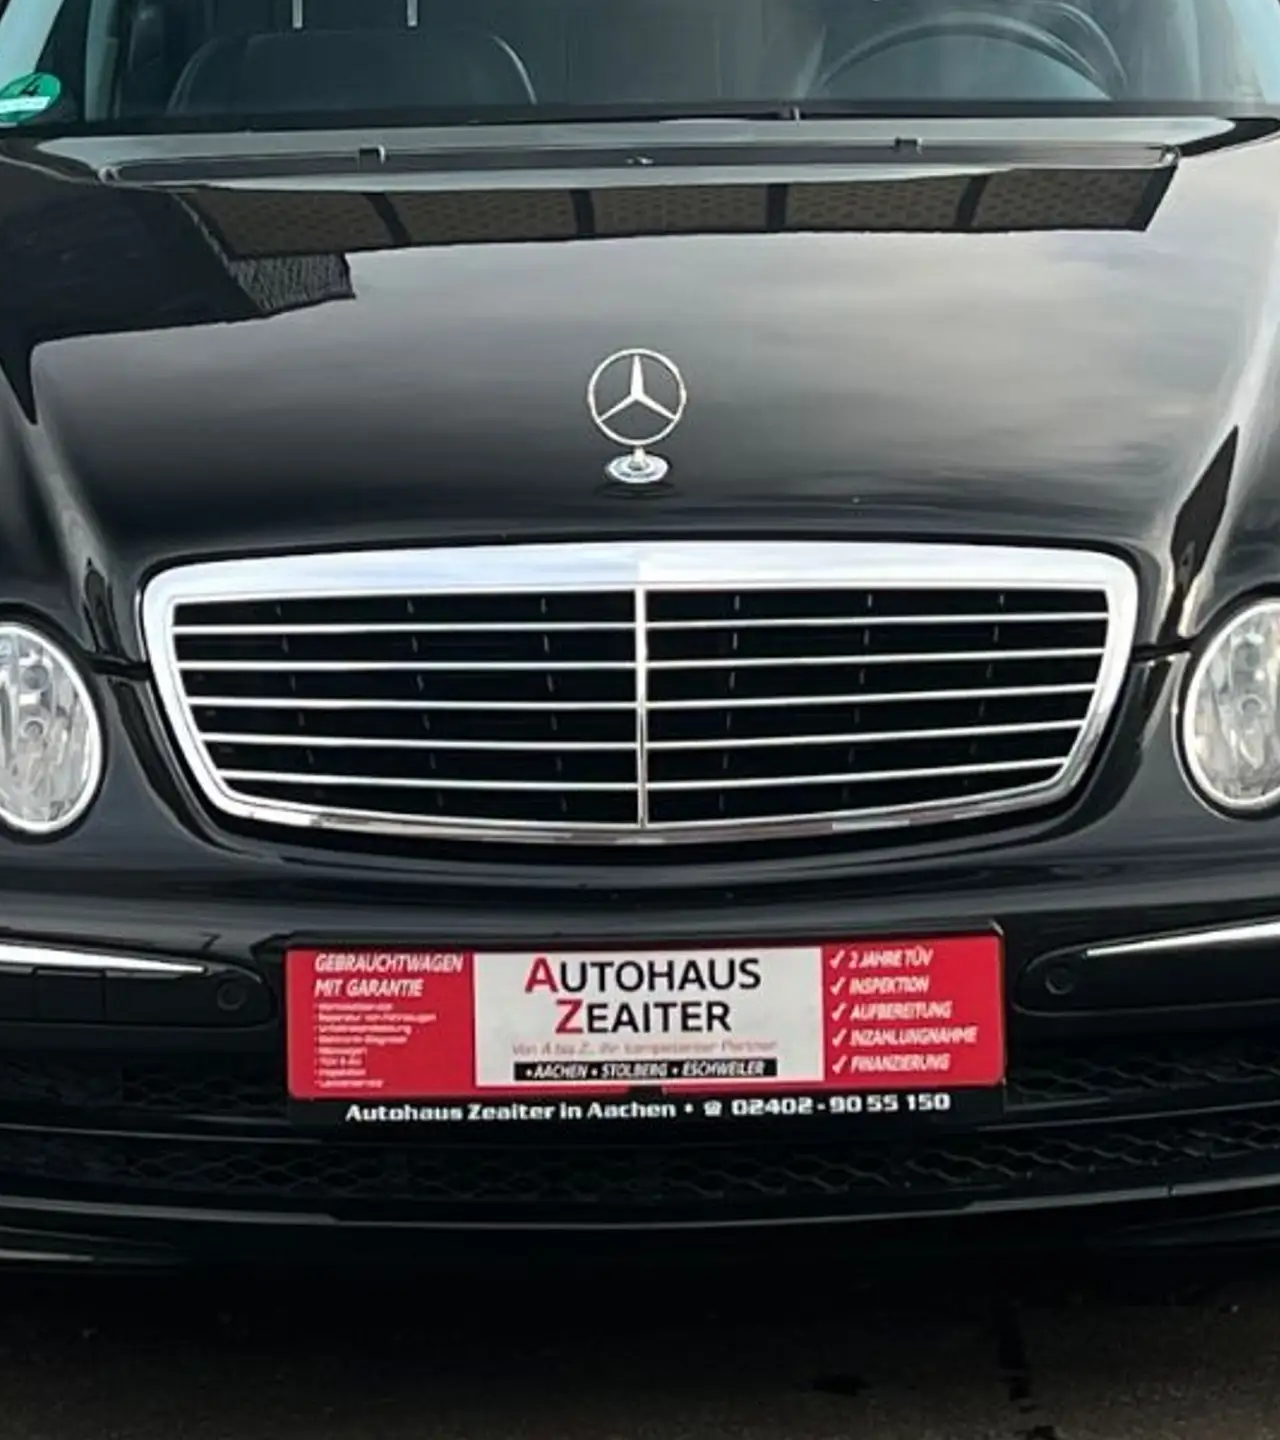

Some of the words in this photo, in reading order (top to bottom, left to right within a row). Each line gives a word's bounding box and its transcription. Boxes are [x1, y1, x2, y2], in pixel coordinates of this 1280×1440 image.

[315, 952, 463, 972] GEBRAUCHTWAGEN
[848, 950, 859, 969] 2
[859, 949, 903, 968] JAHRE
[905, 945, 934, 967] TÜV
[525, 957, 762, 993] AUTOHAUS
[849, 975, 930, 995] INSPEKTION
[314, 979, 343, 997] MIT
[346, 978, 424, 997] GARANTIE
[556, 999, 732, 1035] ZEAITER
[849, 1000, 953, 1021] AUFBEREITUNG
[849, 1026, 979, 1047] INZAHLUNGNAHME
[534, 1063, 588, 1078] AACHEN
[601, 1062, 667, 1078] STOLBERG
[682, 1060, 764, 1077] ESCHWEILER
[850, 1053, 951, 1072] FINANZIERUNG
[345, 1103, 463, 1122] Autohaus
[467, 1102, 556, 1121] Zeaiter
[560, 1101, 582, 1119] in
[587, 1100, 676, 1120] Aachen
[866, 1094, 898, 1112] 55
[906, 1092, 950, 1111] 150
